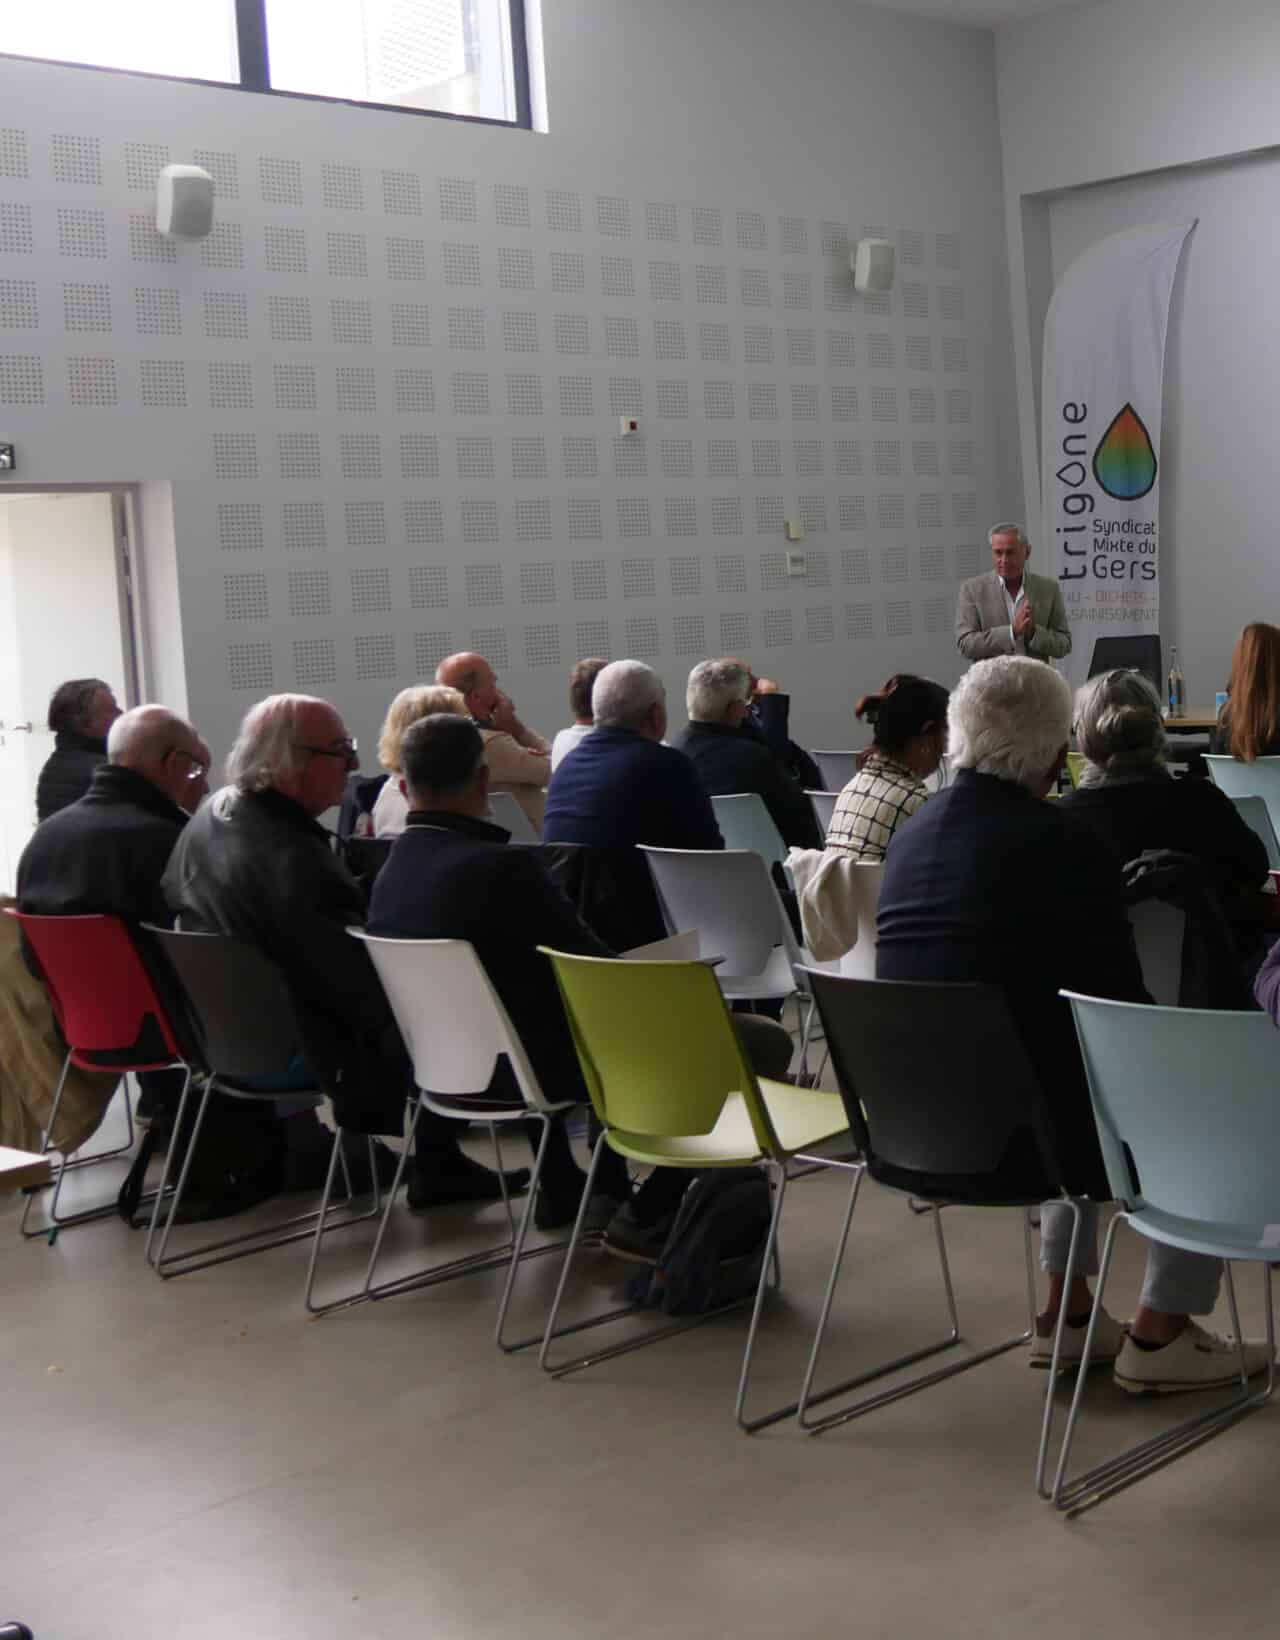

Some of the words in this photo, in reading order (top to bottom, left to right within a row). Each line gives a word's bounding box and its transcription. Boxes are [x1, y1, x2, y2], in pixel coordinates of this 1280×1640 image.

[1055, 401, 1096, 581] trigone
[1092, 518, 1157, 537] Syndicat
[1093, 536, 1135, 553] Mixte
[1138, 537, 1156, 554] du
[1091, 553, 1157, 581] Gers
